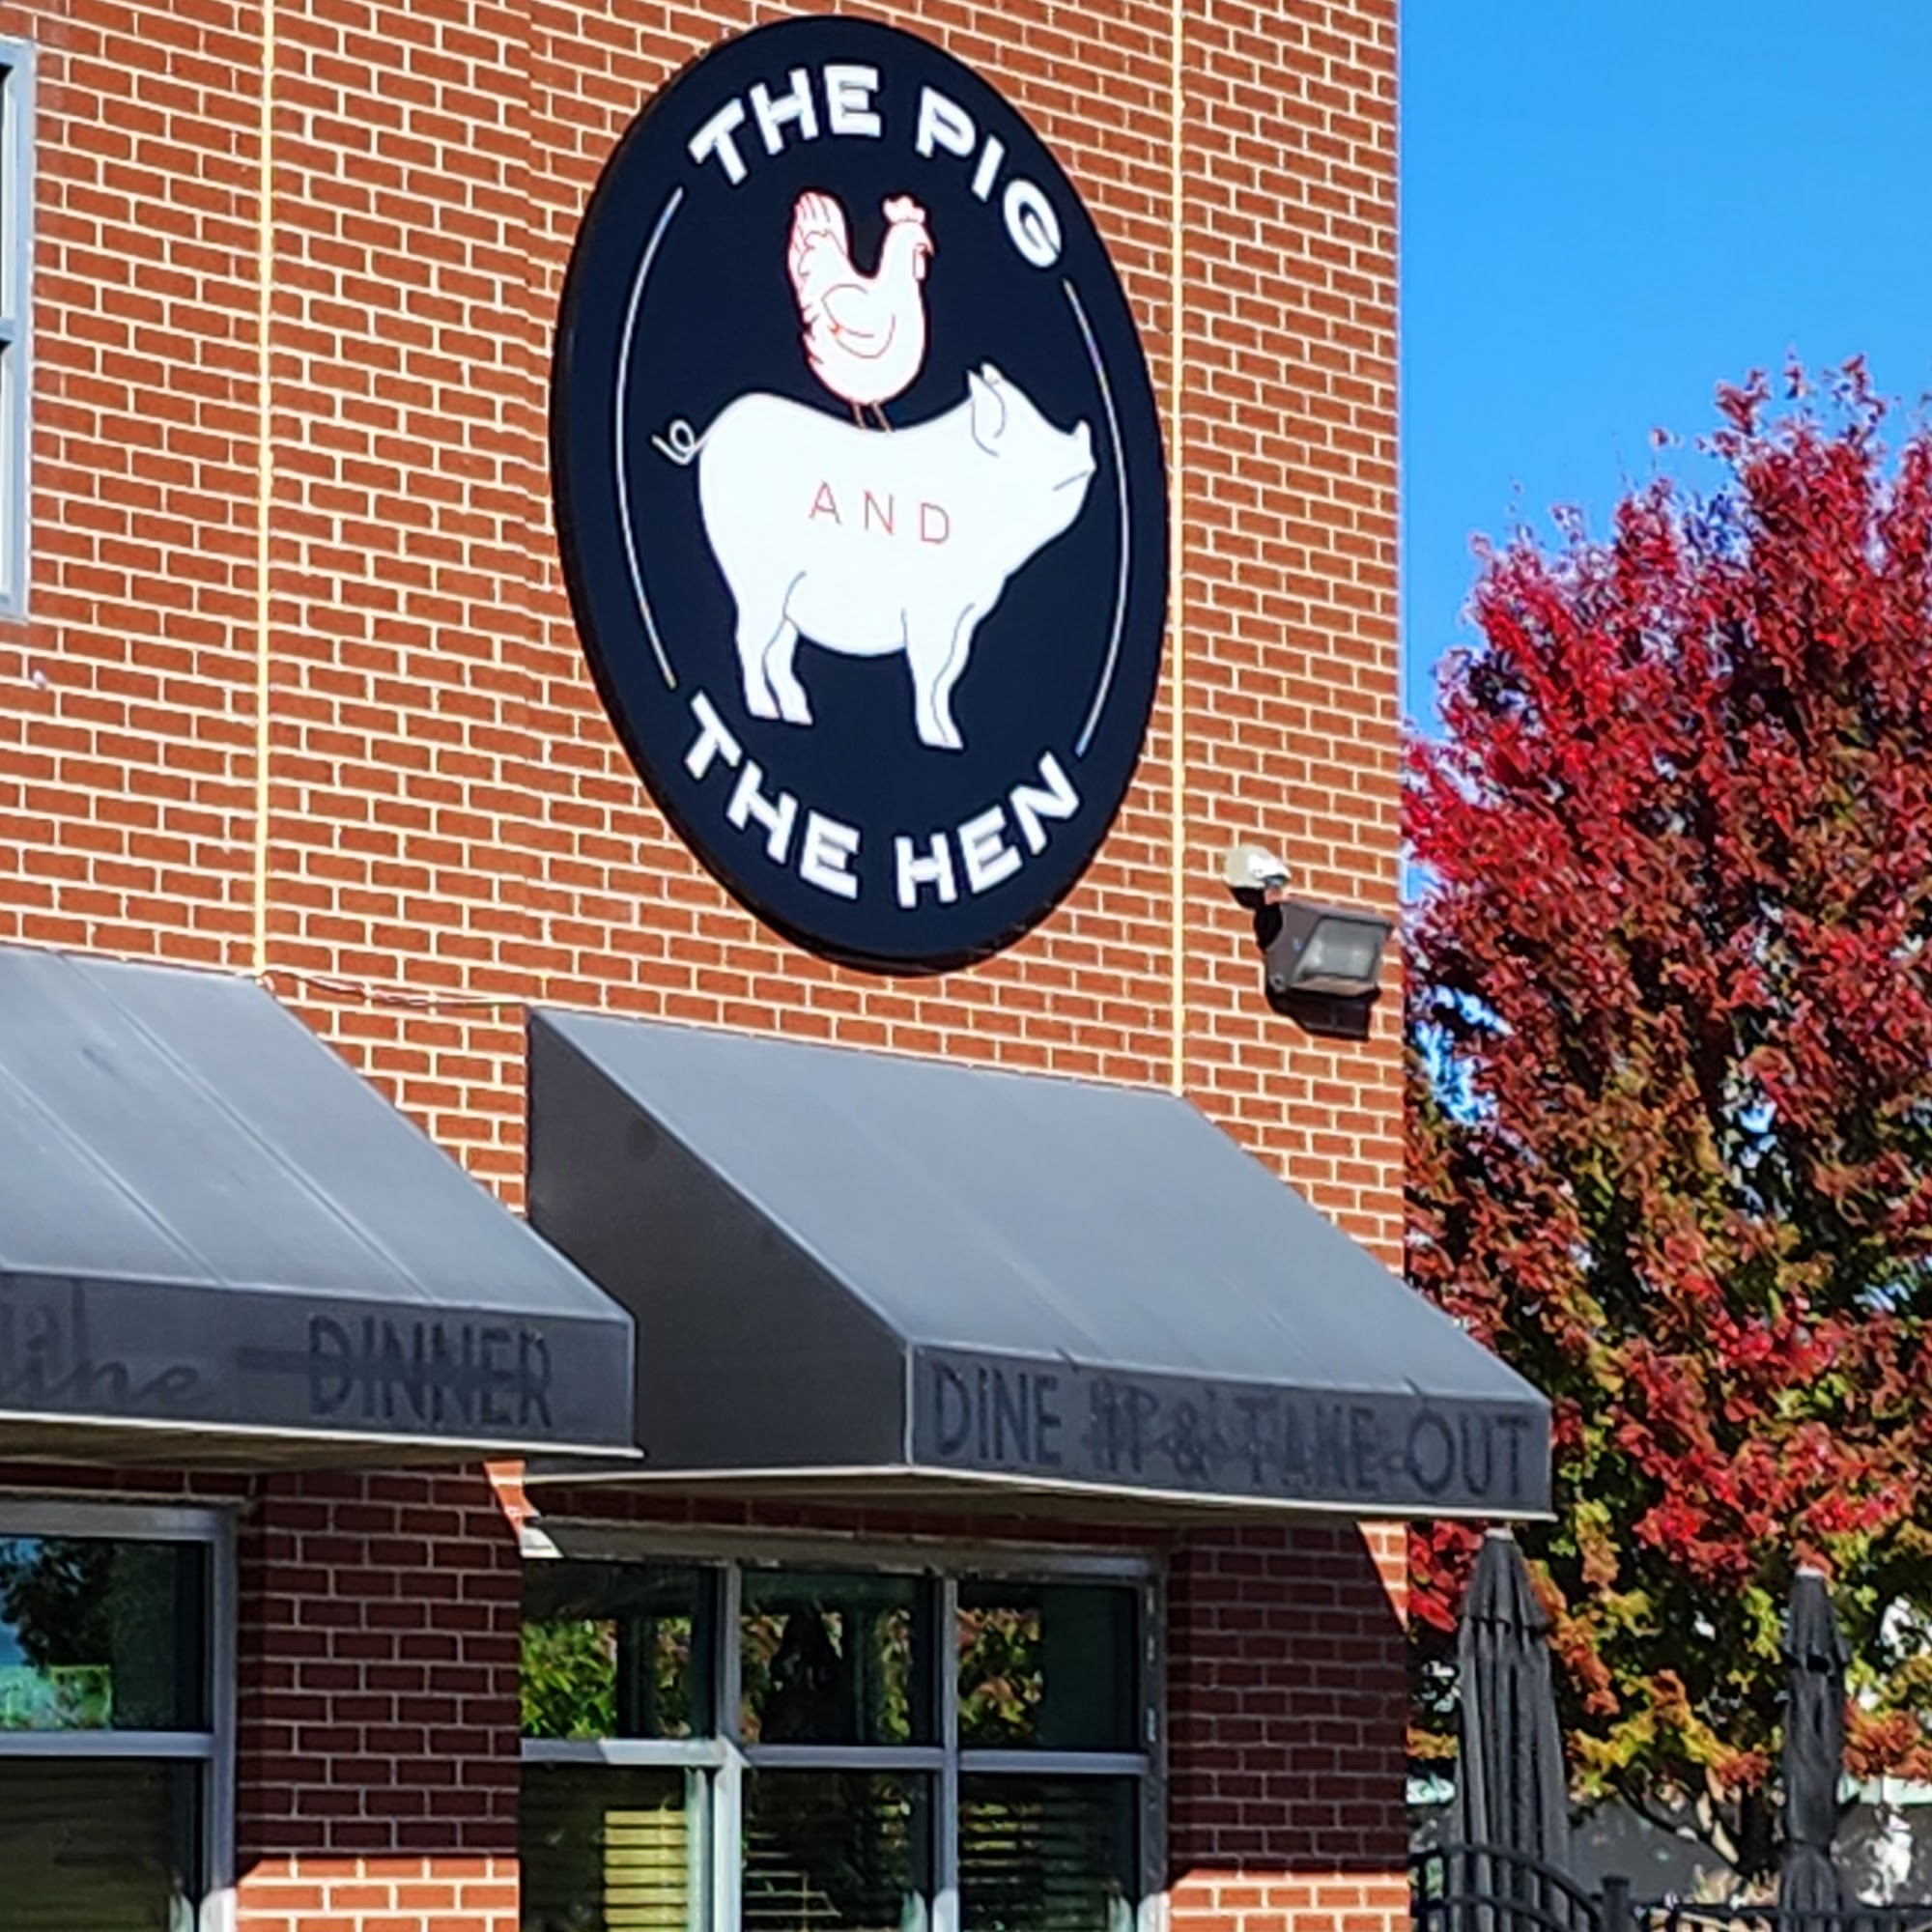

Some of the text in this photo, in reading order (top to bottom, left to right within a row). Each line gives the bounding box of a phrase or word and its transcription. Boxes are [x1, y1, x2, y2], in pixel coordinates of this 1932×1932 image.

[688, 65, 1062, 268] THE PIG
[809, 480, 950, 545] AND
[685, 692, 1079, 909] THE HEN
[307, 1312, 554, 1430] DINNER
[930, 1359, 1063, 1467] DINE
